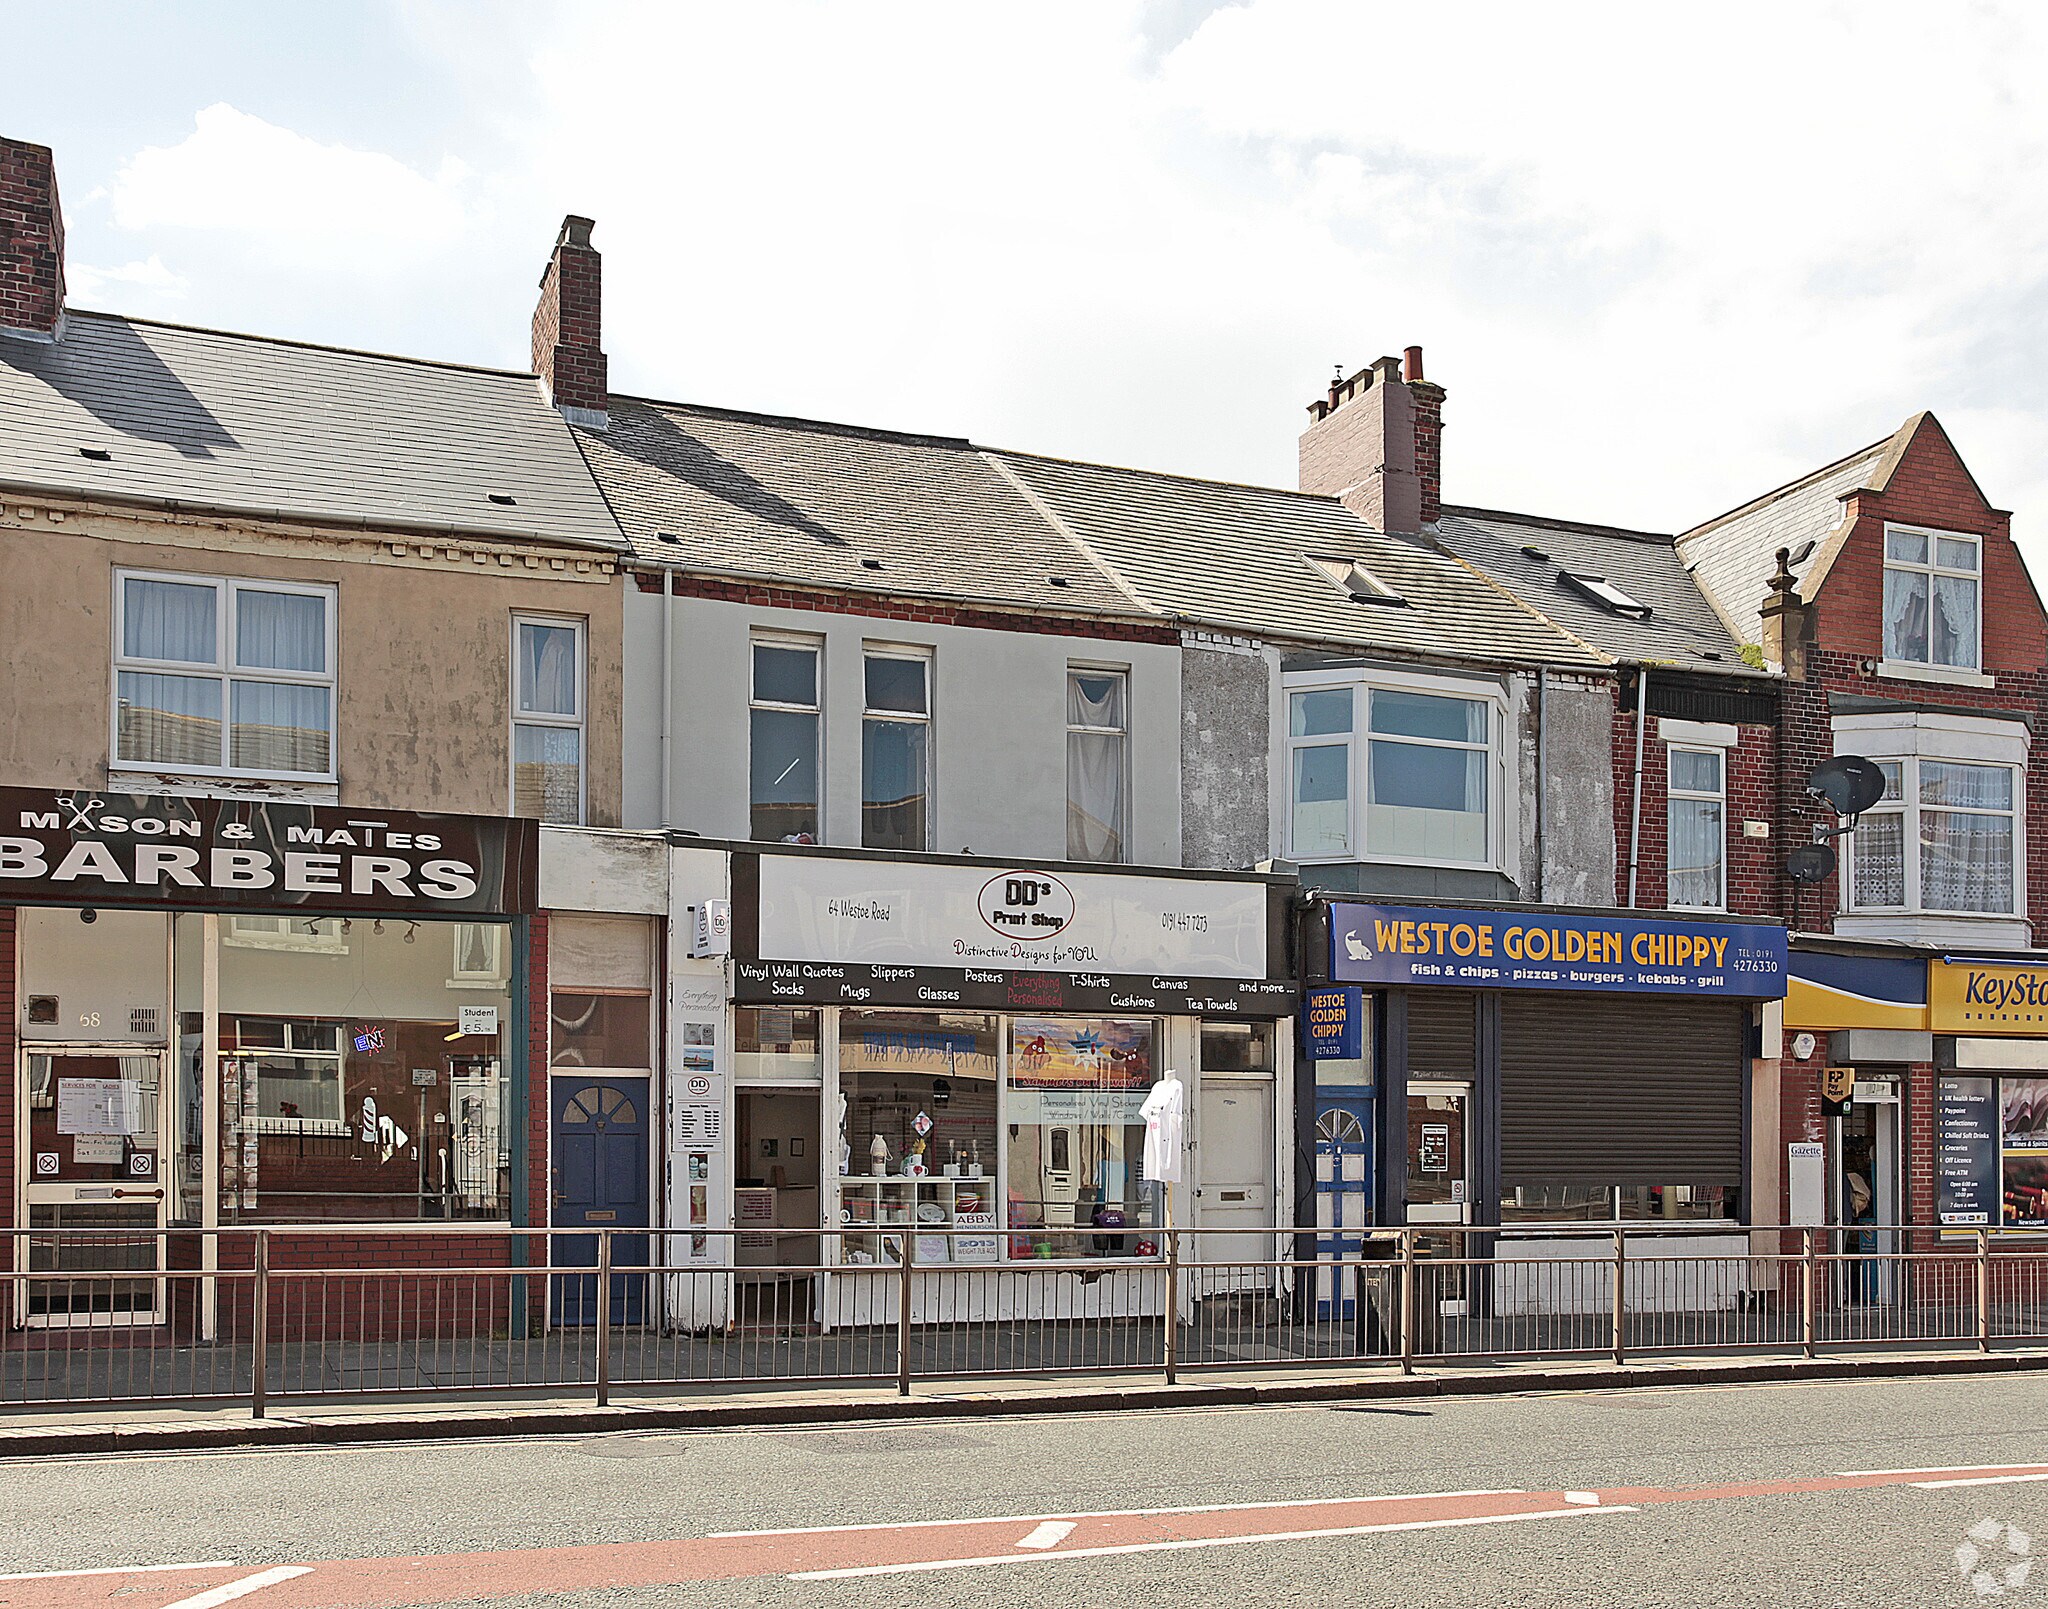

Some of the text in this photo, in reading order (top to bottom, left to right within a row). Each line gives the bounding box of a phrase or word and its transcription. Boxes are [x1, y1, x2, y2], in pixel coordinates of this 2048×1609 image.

[221, 823, 255, 840] &
[287, 820, 442, 851] MATES
[0, 836, 477, 899] BARBERS
[1005, 879, 1051, 906] DD's
[828, 898, 890, 922] 64 Westoe Road
[992, 910, 1064, 930] Print Shop
[1162, 912, 1208, 933] 0191 447 7273
[1374, 919, 1729, 967] WESTOE GOLDEN CHIPPY
[953, 939, 1098, 964] Distinctive Designs for YOU
[1738, 949, 1750, 957] TEL
[1757, 950, 1773, 958] 0191
[739, 964, 844, 981] Vinyl Wall Quotes
[870, 965, 915, 981] Slippers
[1733, 959, 1778, 973] 4276330
[964, 969, 1003, 983] Posters
[1011, 971, 1061, 990] Everything
[1069, 974, 1110, 988] T-Shirts
[1410, 963, 1441, 976] fish
[1444, 965, 1456, 976] &
[1459, 966, 1499, 979] chips
[1513, 968, 1558, 980] pizzas
[1570, 970, 1624, 984] burgers
[1637, 972, 1686, 985] kebabs
[1697, 975, 1724, 987] grill
[772, 981, 804, 996] Socks
[1151, 977, 1188, 990] Canvas
[1238, 982, 1257, 993] and
[1260, 985, 1285, 994] more
[682, 989, 718, 1003] Everything
[840, 984, 871, 1000] Mugs
[918, 986, 960, 1000] Glasses
[1007, 989, 1063, 1007] Personalised
[679, 1001, 722, 1011] Personalised
[1110, 993, 1156, 1008] Cushions
[1186, 998, 1238, 1012] Tea Towels
[1311, 994, 1345, 1008] WESTOE
[80, 1011, 100, 1027] 68
[464, 1008, 494, 1017] Student
[1309, 1008, 1347, 1023] GOLDEN
[1311, 1024, 1344, 1038] CHIPPY
[1315, 1046, 1341, 1055] 4276330
[1022, 1075, 1074, 1087] Summers
[1076, 1078, 1091, 1087] on
[1041, 1095, 1086, 1107] Personalised
[1088, 1096, 1109, 1108] Vinyl
[1791, 1146, 1821, 1155] Gazette
[956, 1214, 994, 1224] ABBY
